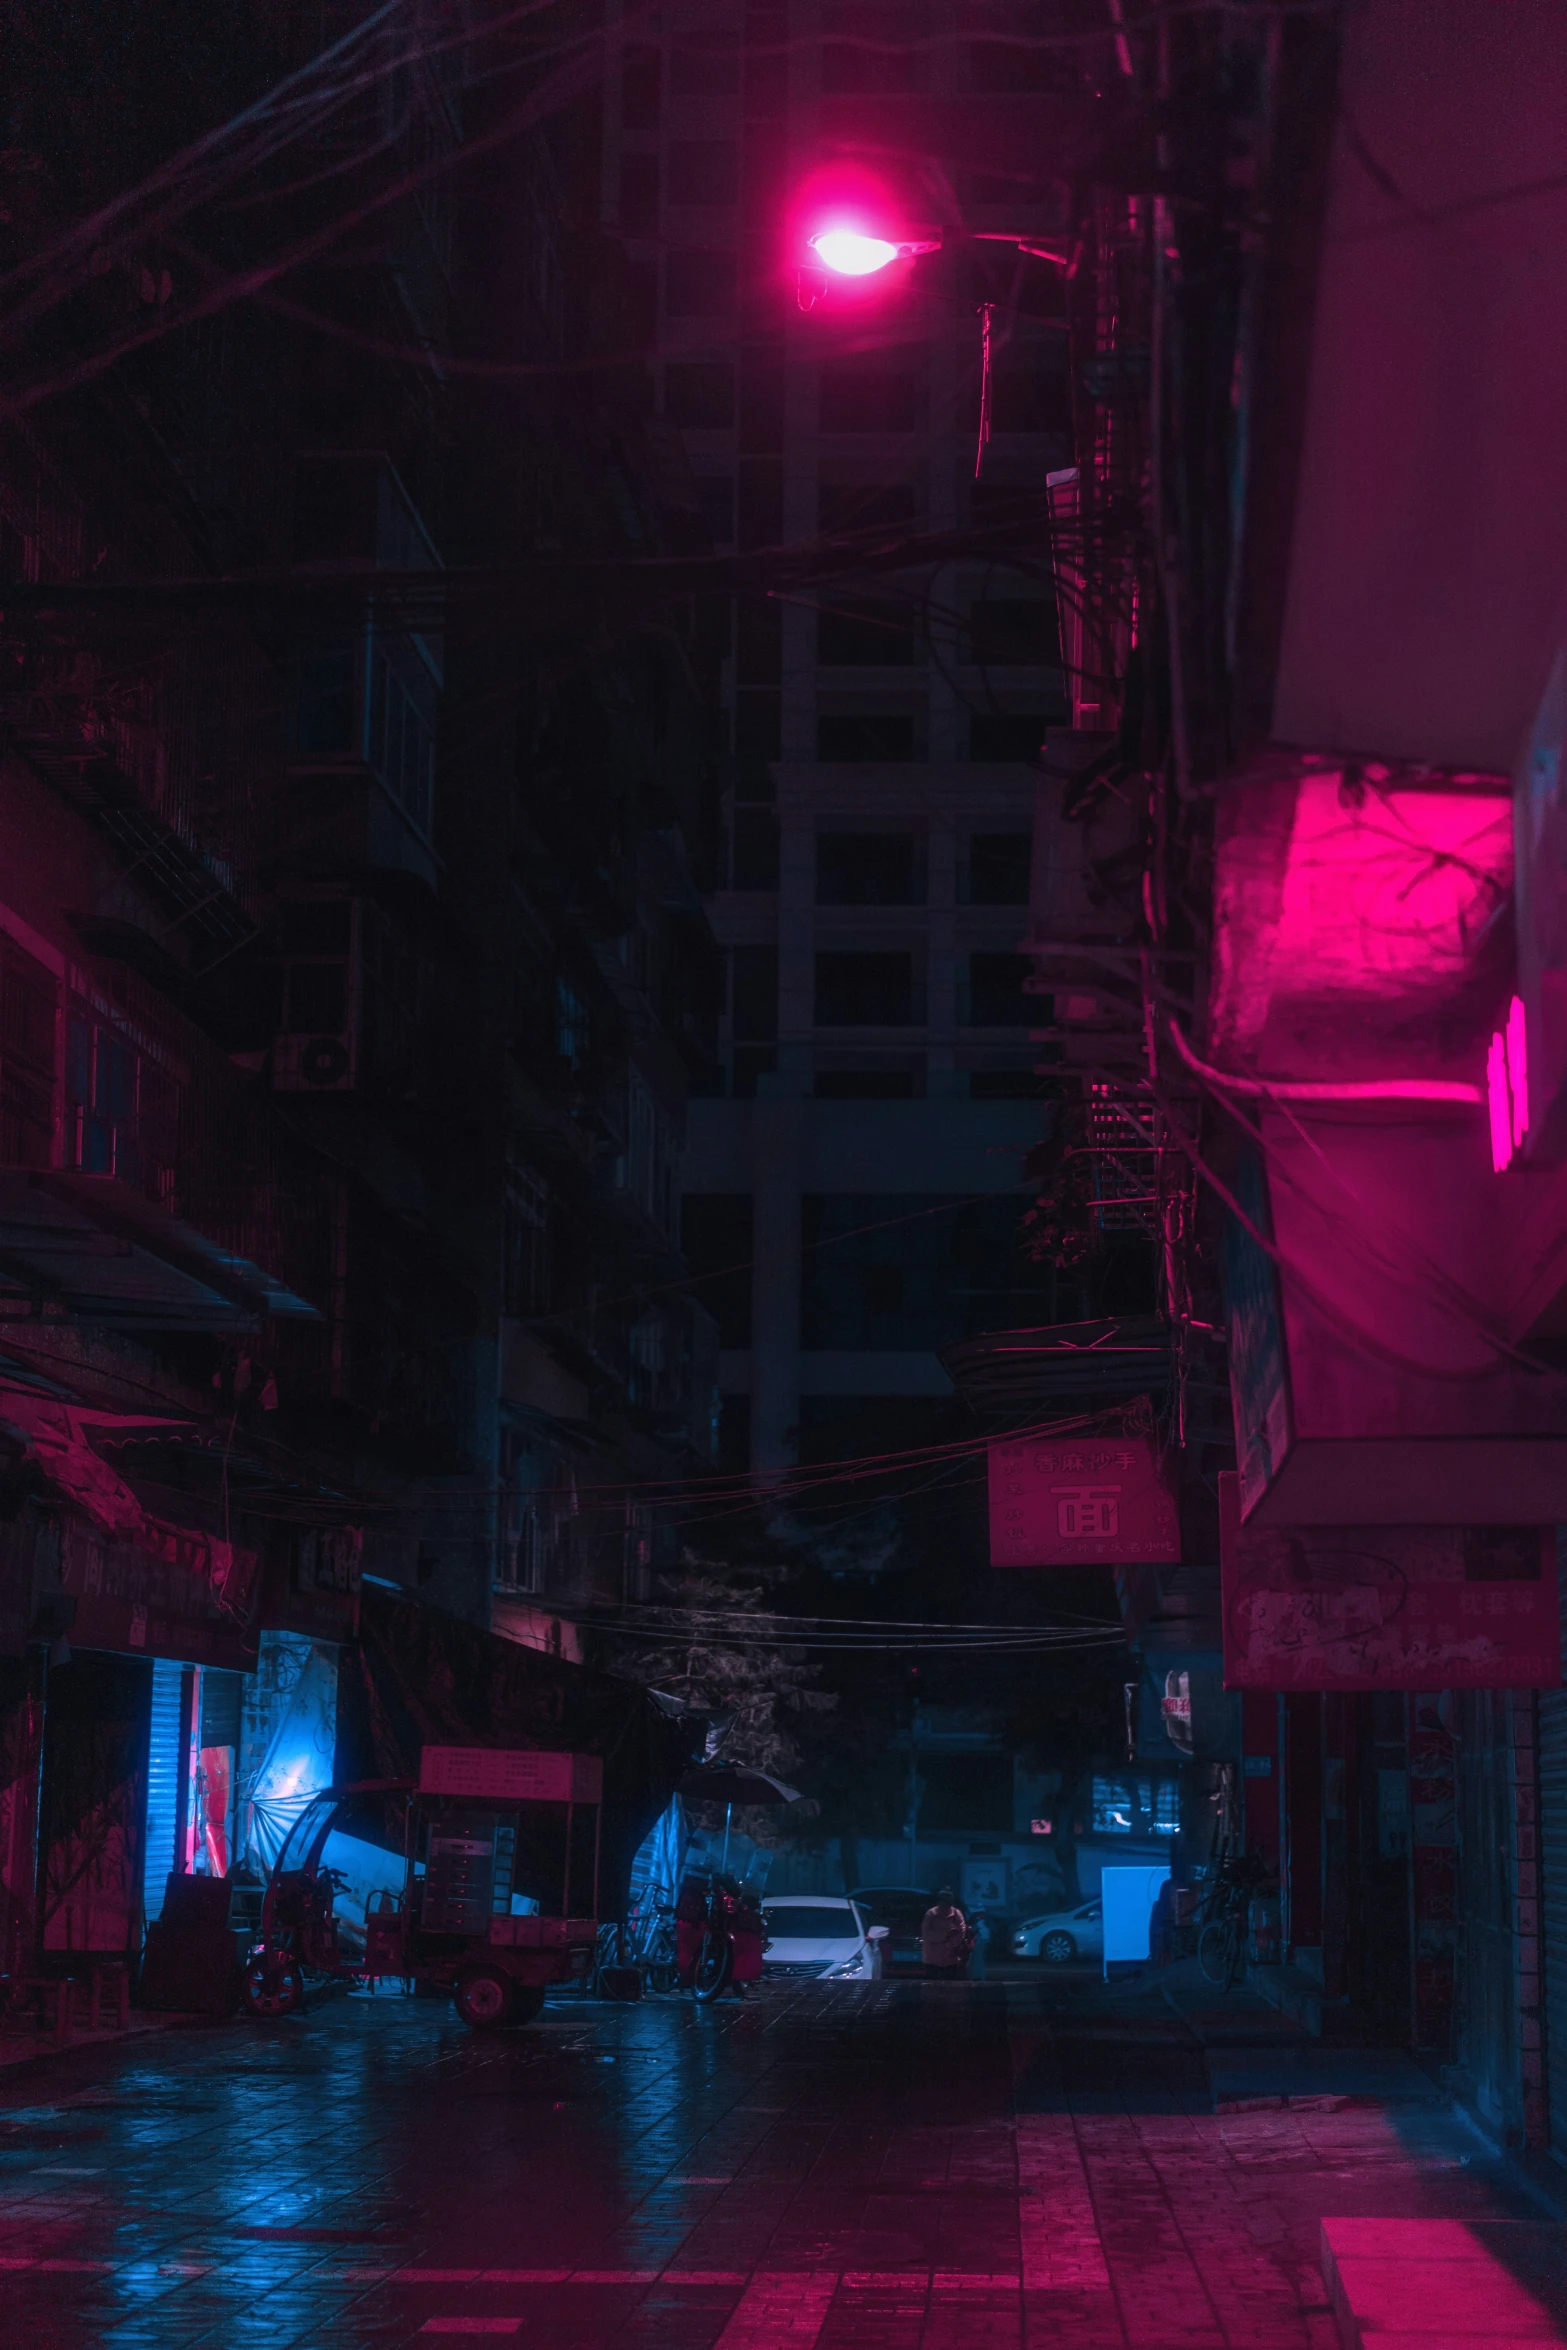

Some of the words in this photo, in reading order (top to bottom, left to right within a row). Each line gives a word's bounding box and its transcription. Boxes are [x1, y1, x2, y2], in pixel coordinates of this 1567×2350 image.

[1033, 1451, 1138, 1474] 香麻抄手
[1049, 1484, 1122, 1539] 面
